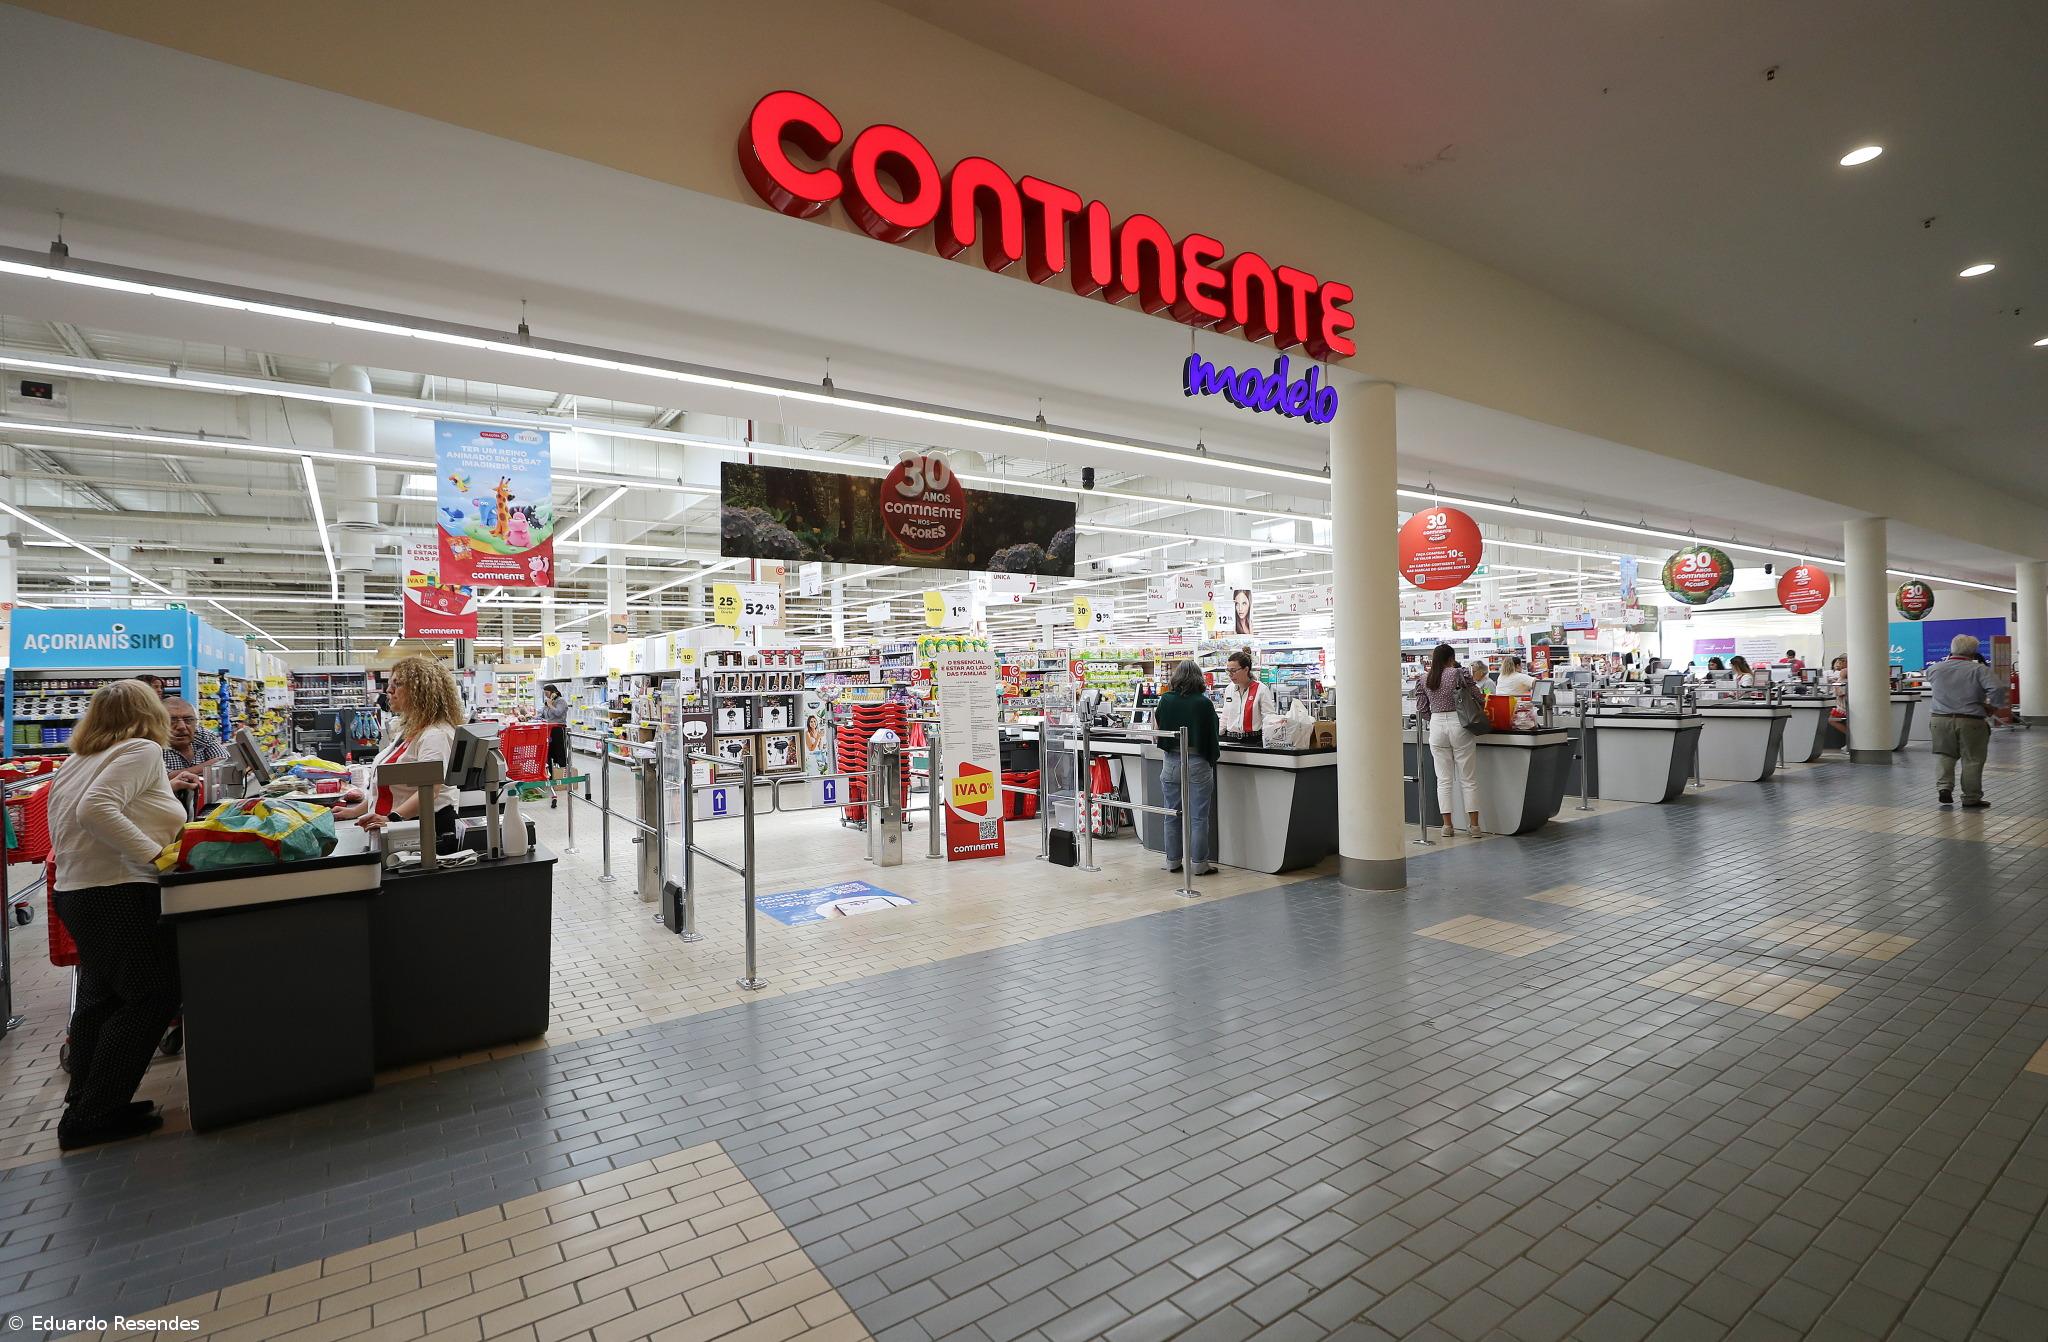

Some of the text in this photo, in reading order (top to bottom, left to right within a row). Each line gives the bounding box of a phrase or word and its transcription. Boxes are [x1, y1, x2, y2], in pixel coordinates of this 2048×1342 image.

[738, 90, 1356, 362] CONTINENTE
[1184, 352, 1338, 424] modelo
[461, 445, 480, 453] TER
[499, 449, 527, 457] REINO
[446, 451, 493, 461] ANIMADO
[511, 457, 541, 465] CASA?
[462, 460, 510, 470] IMAGINEM
[895, 450, 951, 497] 30
[922, 491, 951, 504] ANOS
[884, 501, 962, 520] CONTINENTE
[1426, 512, 1447, 530] 30
[900, 523, 946, 539] AÇORES
[1447, 549, 1458, 558] 10
[1681, 551, 1712, 572] 30
[471, 572, 525, 580] CONTINENTE
[1795, 568, 1809, 579] 30
[1029, 582, 1036, 593] 7
[1906, 584, 1923, 598] 30
[1207, 591, 1214, 600] 9
[1289, 603, 1297, 612] 12
[1433, 601, 1442, 610] 13
[1535, 650, 1546, 658] 30
[955, 783, 978, 796] IVA
[953, 842, 999, 853] CONTINENTE
